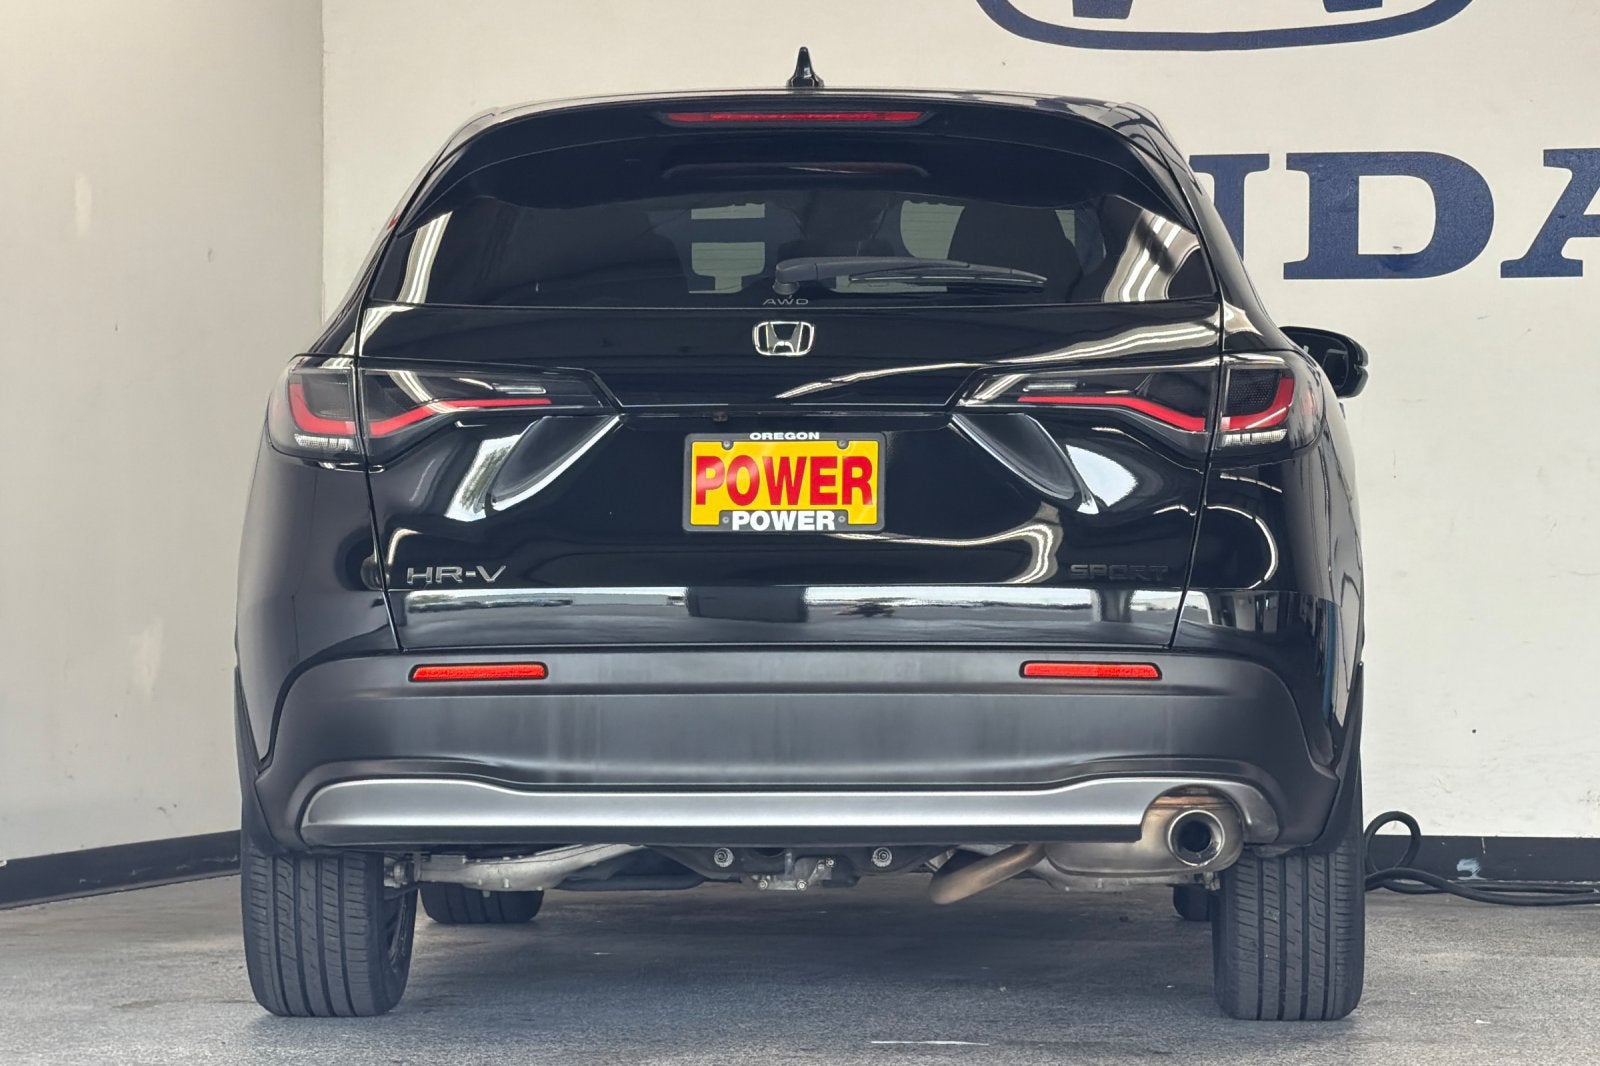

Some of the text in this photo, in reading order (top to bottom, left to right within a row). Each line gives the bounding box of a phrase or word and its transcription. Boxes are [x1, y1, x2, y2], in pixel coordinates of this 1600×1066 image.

[762, 297, 809, 306] AWD
[749, 431, 820, 441] OREGON
[695, 454, 874, 506] POWER
[731, 511, 836, 531] POWER
[406, 565, 507, 584] HR-V
[1070, 564, 1169, 581] SPORT
